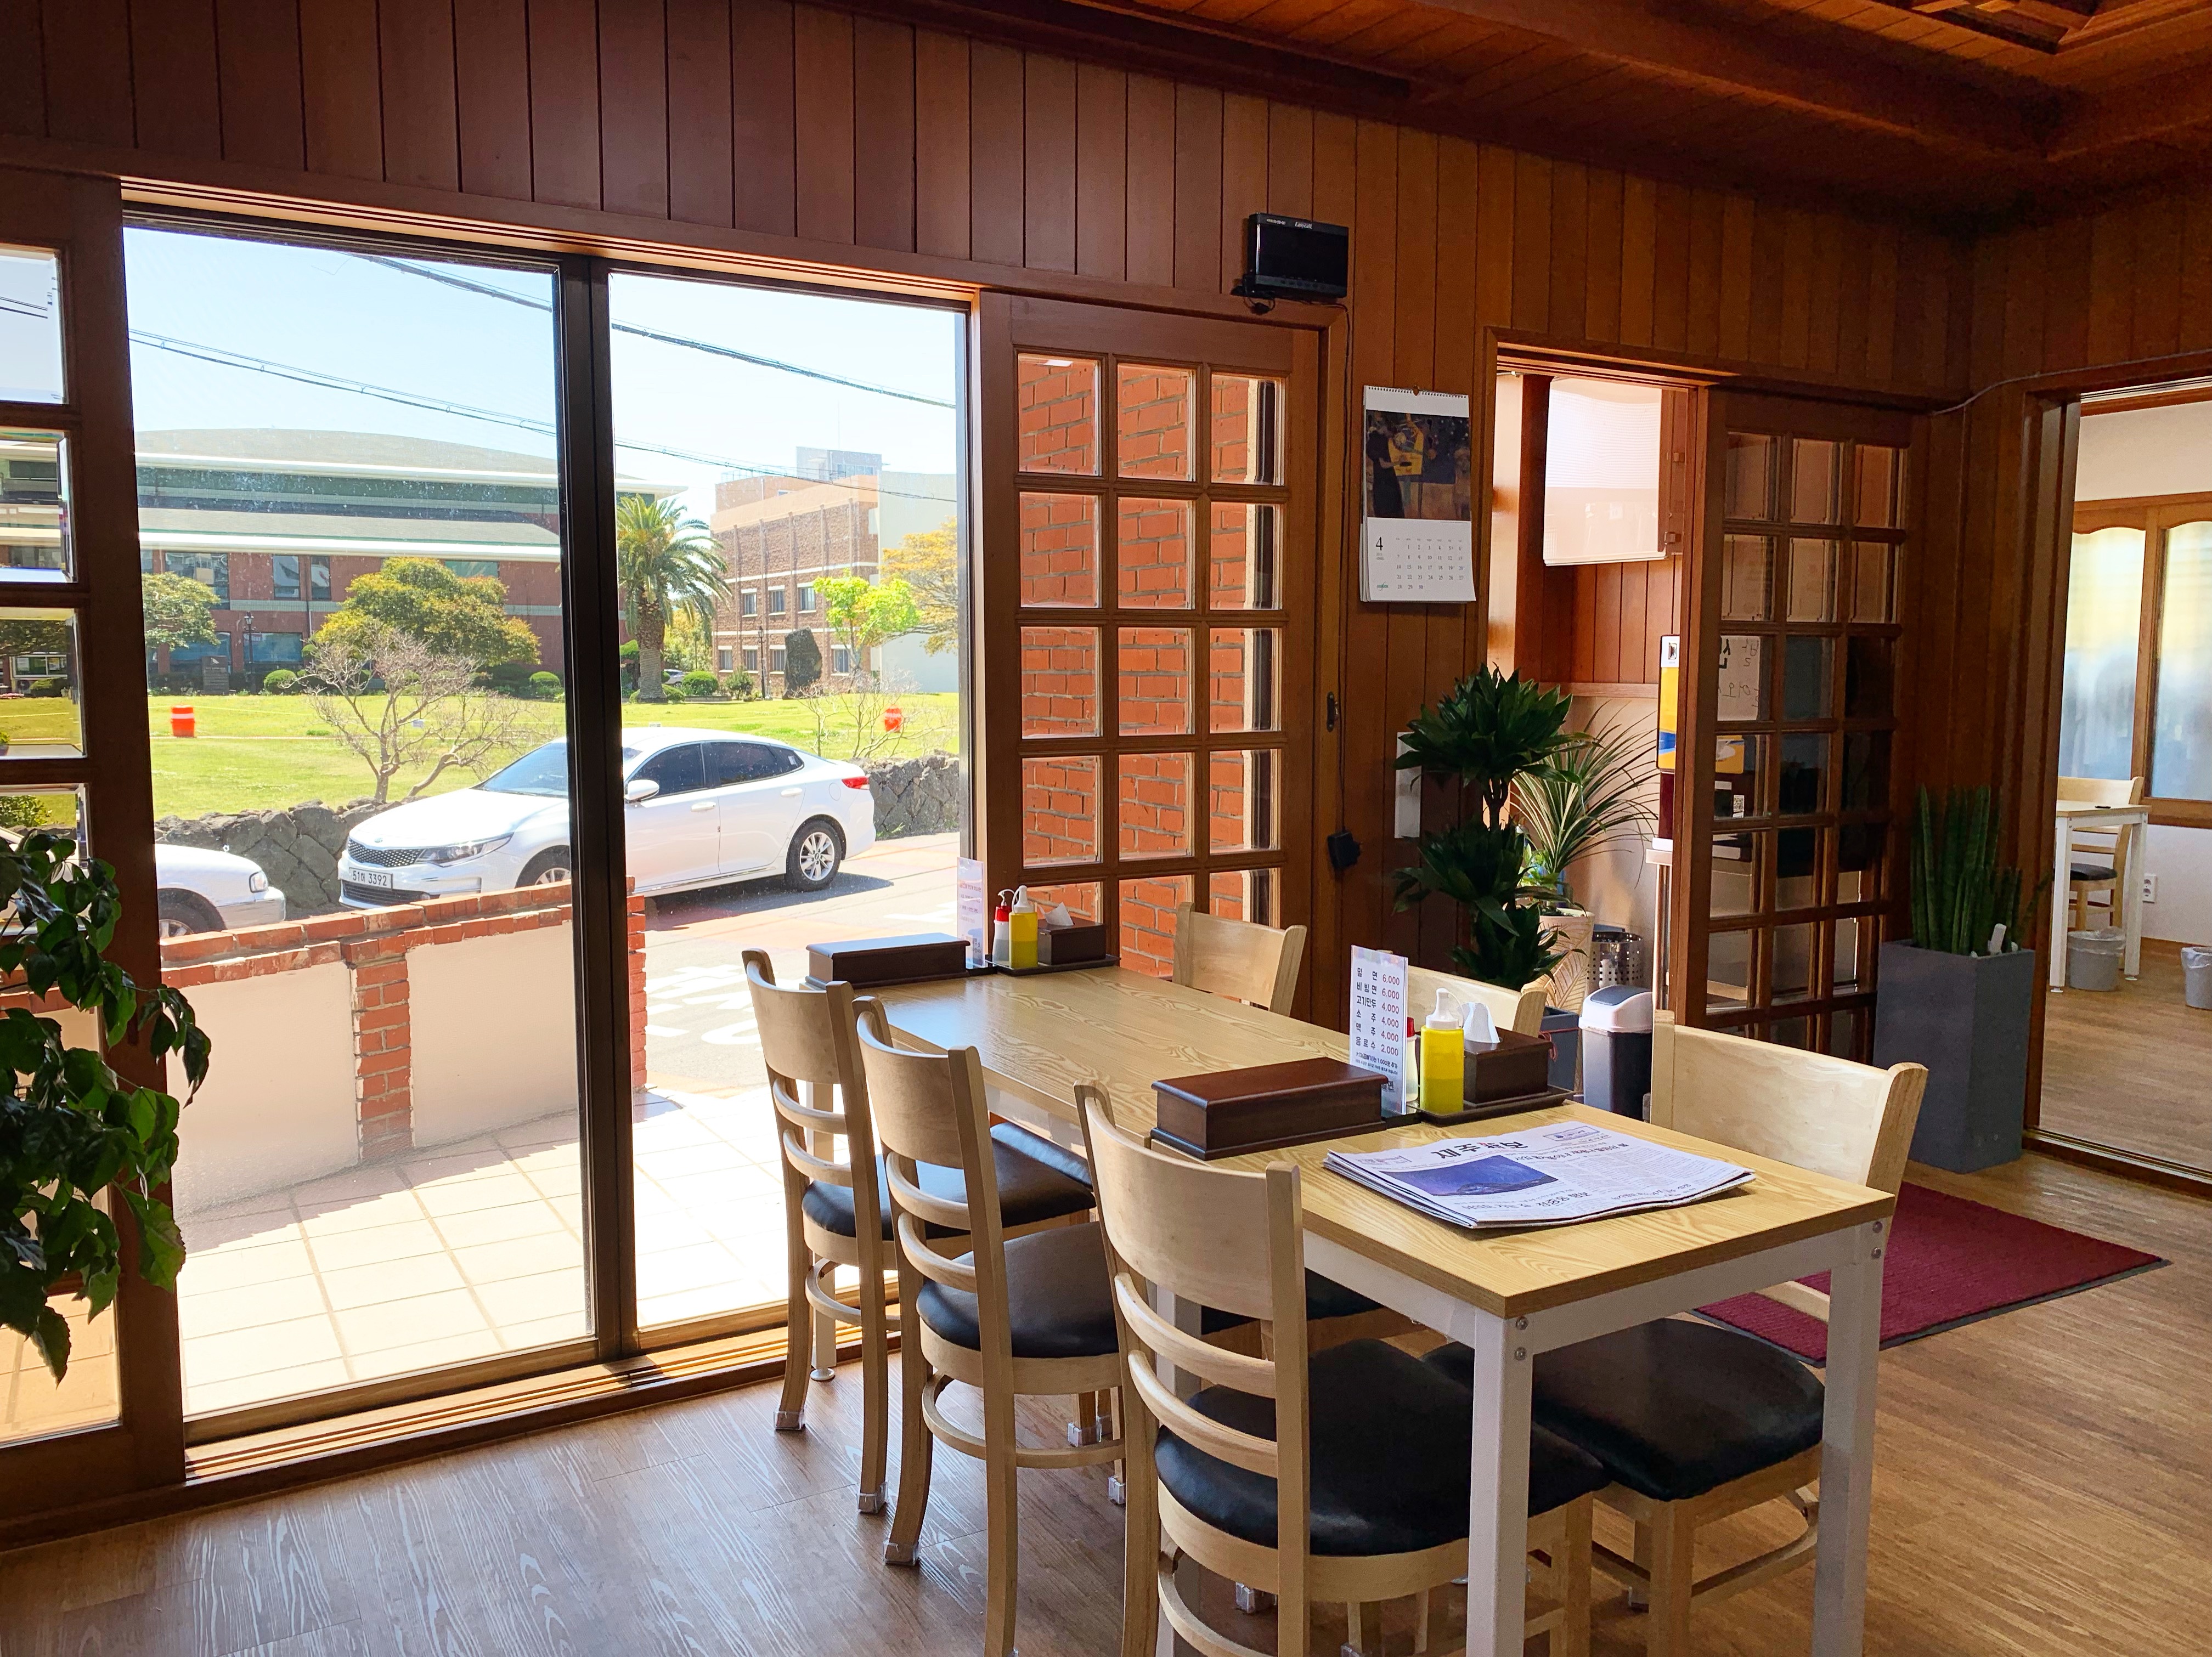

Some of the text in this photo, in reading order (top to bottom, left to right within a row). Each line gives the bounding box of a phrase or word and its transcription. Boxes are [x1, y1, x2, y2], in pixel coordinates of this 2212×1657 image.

[1375, 536, 1383, 551] 4
[368, 873, 387, 886] 3392
[1383, 974, 1400, 986] 6,000
[1382, 988, 1400, 1000] 6,000
[1356, 996, 1399, 1014] 고기만두 4,000
[1381, 1016, 1399, 1028] 4,000
[1381, 1031, 1398, 1042] 4,000
